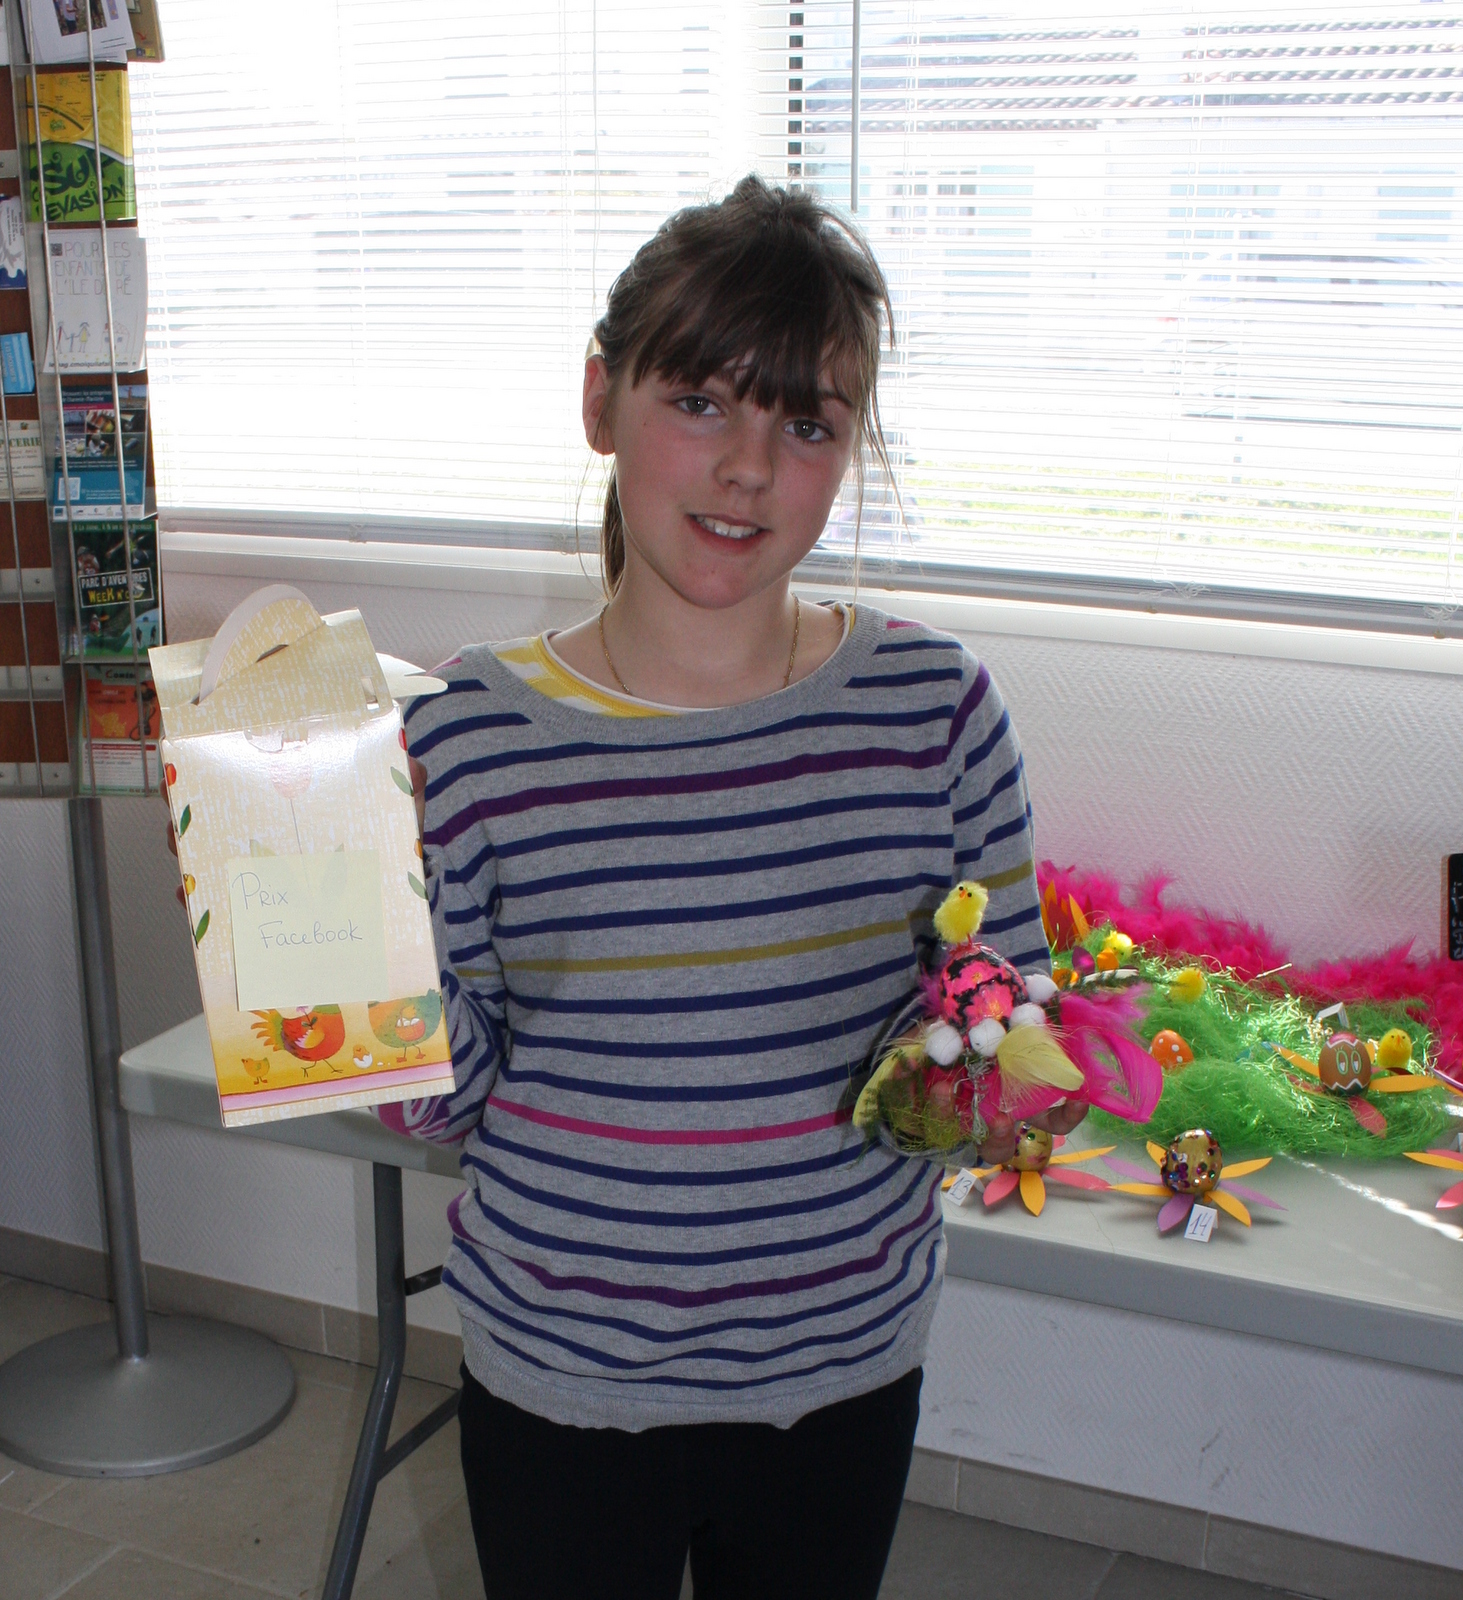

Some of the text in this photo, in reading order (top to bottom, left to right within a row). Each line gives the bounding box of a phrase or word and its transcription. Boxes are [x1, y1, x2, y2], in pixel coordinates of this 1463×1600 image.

[64, 242, 101, 258] POUR
[81, 571, 149, 589] PARC D'AVENURES
[87, 587, 115, 604] WEEK
[950, 1176, 973, 1201] 13
[1188, 1212, 1213, 1237] 14
